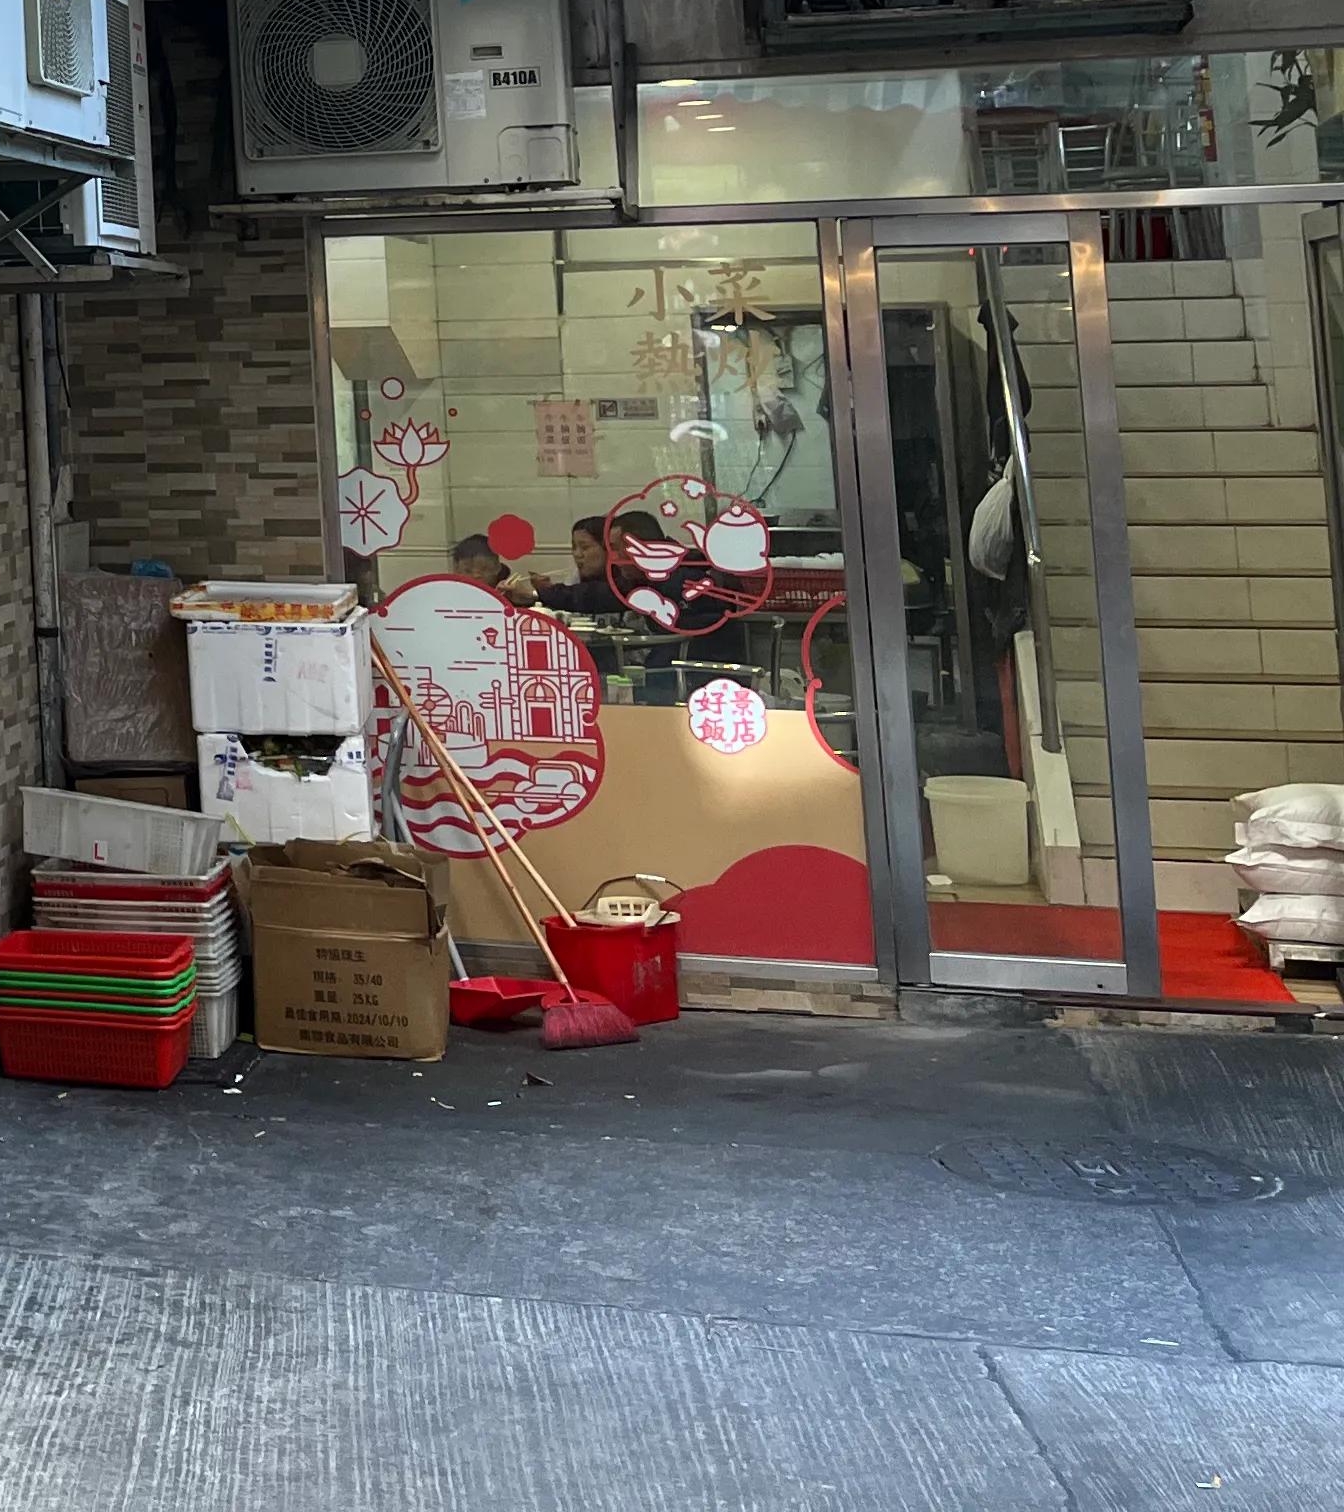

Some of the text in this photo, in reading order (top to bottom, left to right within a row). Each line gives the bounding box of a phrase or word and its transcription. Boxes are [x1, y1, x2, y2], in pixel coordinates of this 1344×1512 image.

[492, 70, 538, 88] R410A
[626, 261, 777, 326] 小菜
[629, 329, 774, 394] 熱炒
[694, 690, 755, 717] 好景
[696, 716, 756, 743] 飯店
